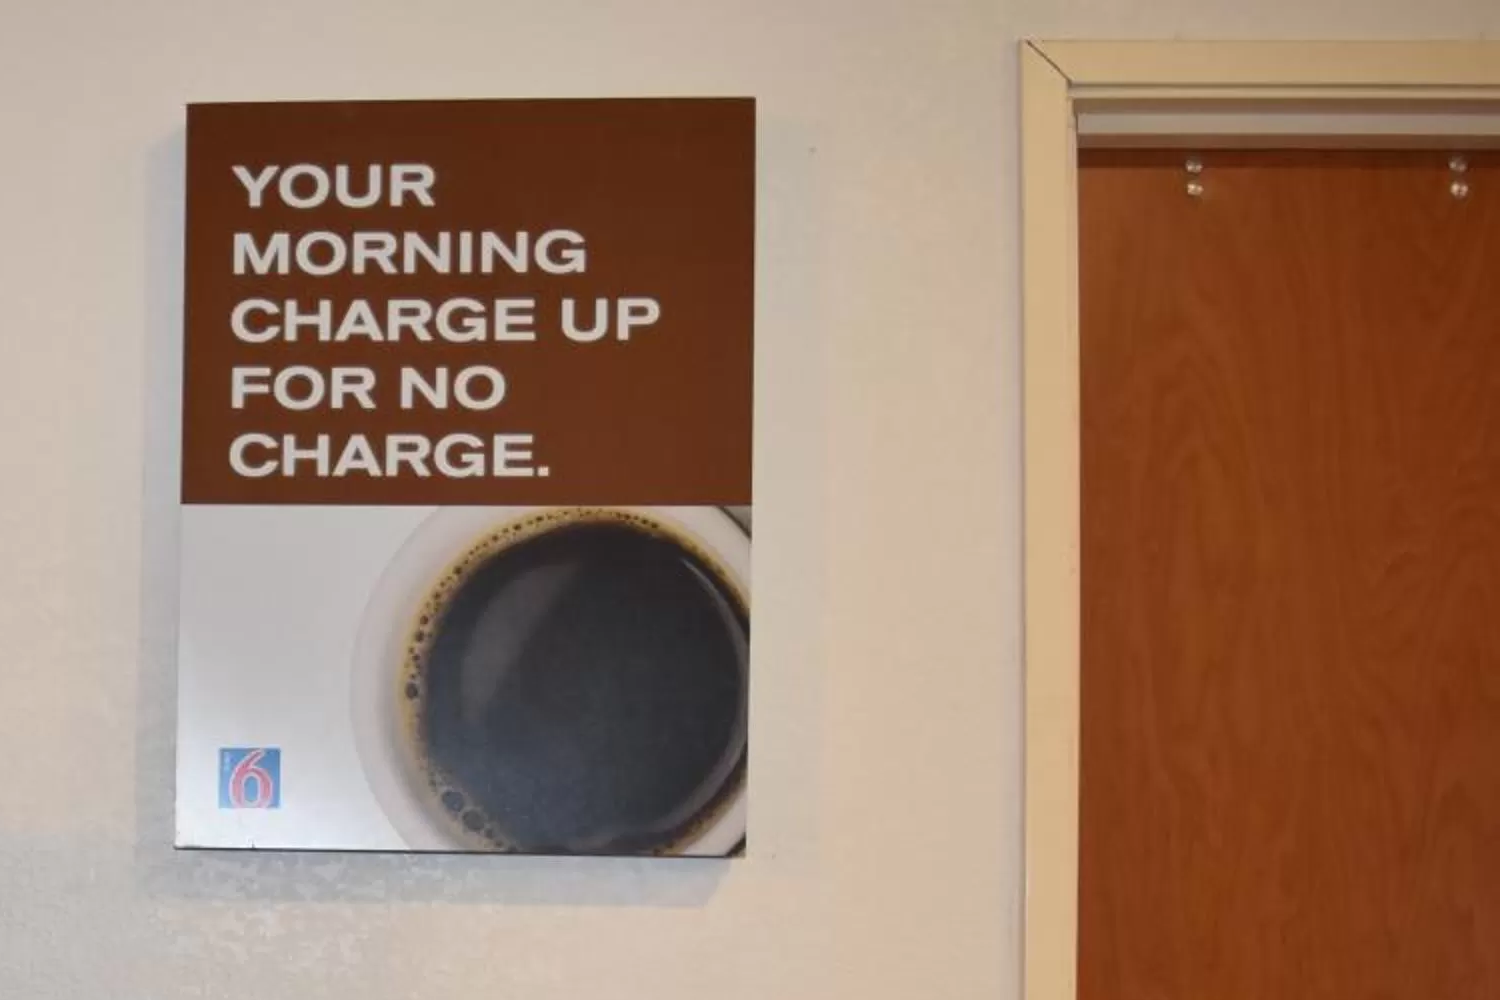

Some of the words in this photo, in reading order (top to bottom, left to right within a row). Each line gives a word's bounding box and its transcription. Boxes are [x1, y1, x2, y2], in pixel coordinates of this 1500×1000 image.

[231, 163, 436, 208] YOUR
[231, 229, 587, 275] MORNING
[230, 298, 537, 342] CHARGE
[560, 297, 661, 341] UP
[230, 365, 377, 410] FOR
[399, 365, 506, 410] NO
[228, 433, 550, 478] CHARGE.
[228, 748, 273, 809] 6
